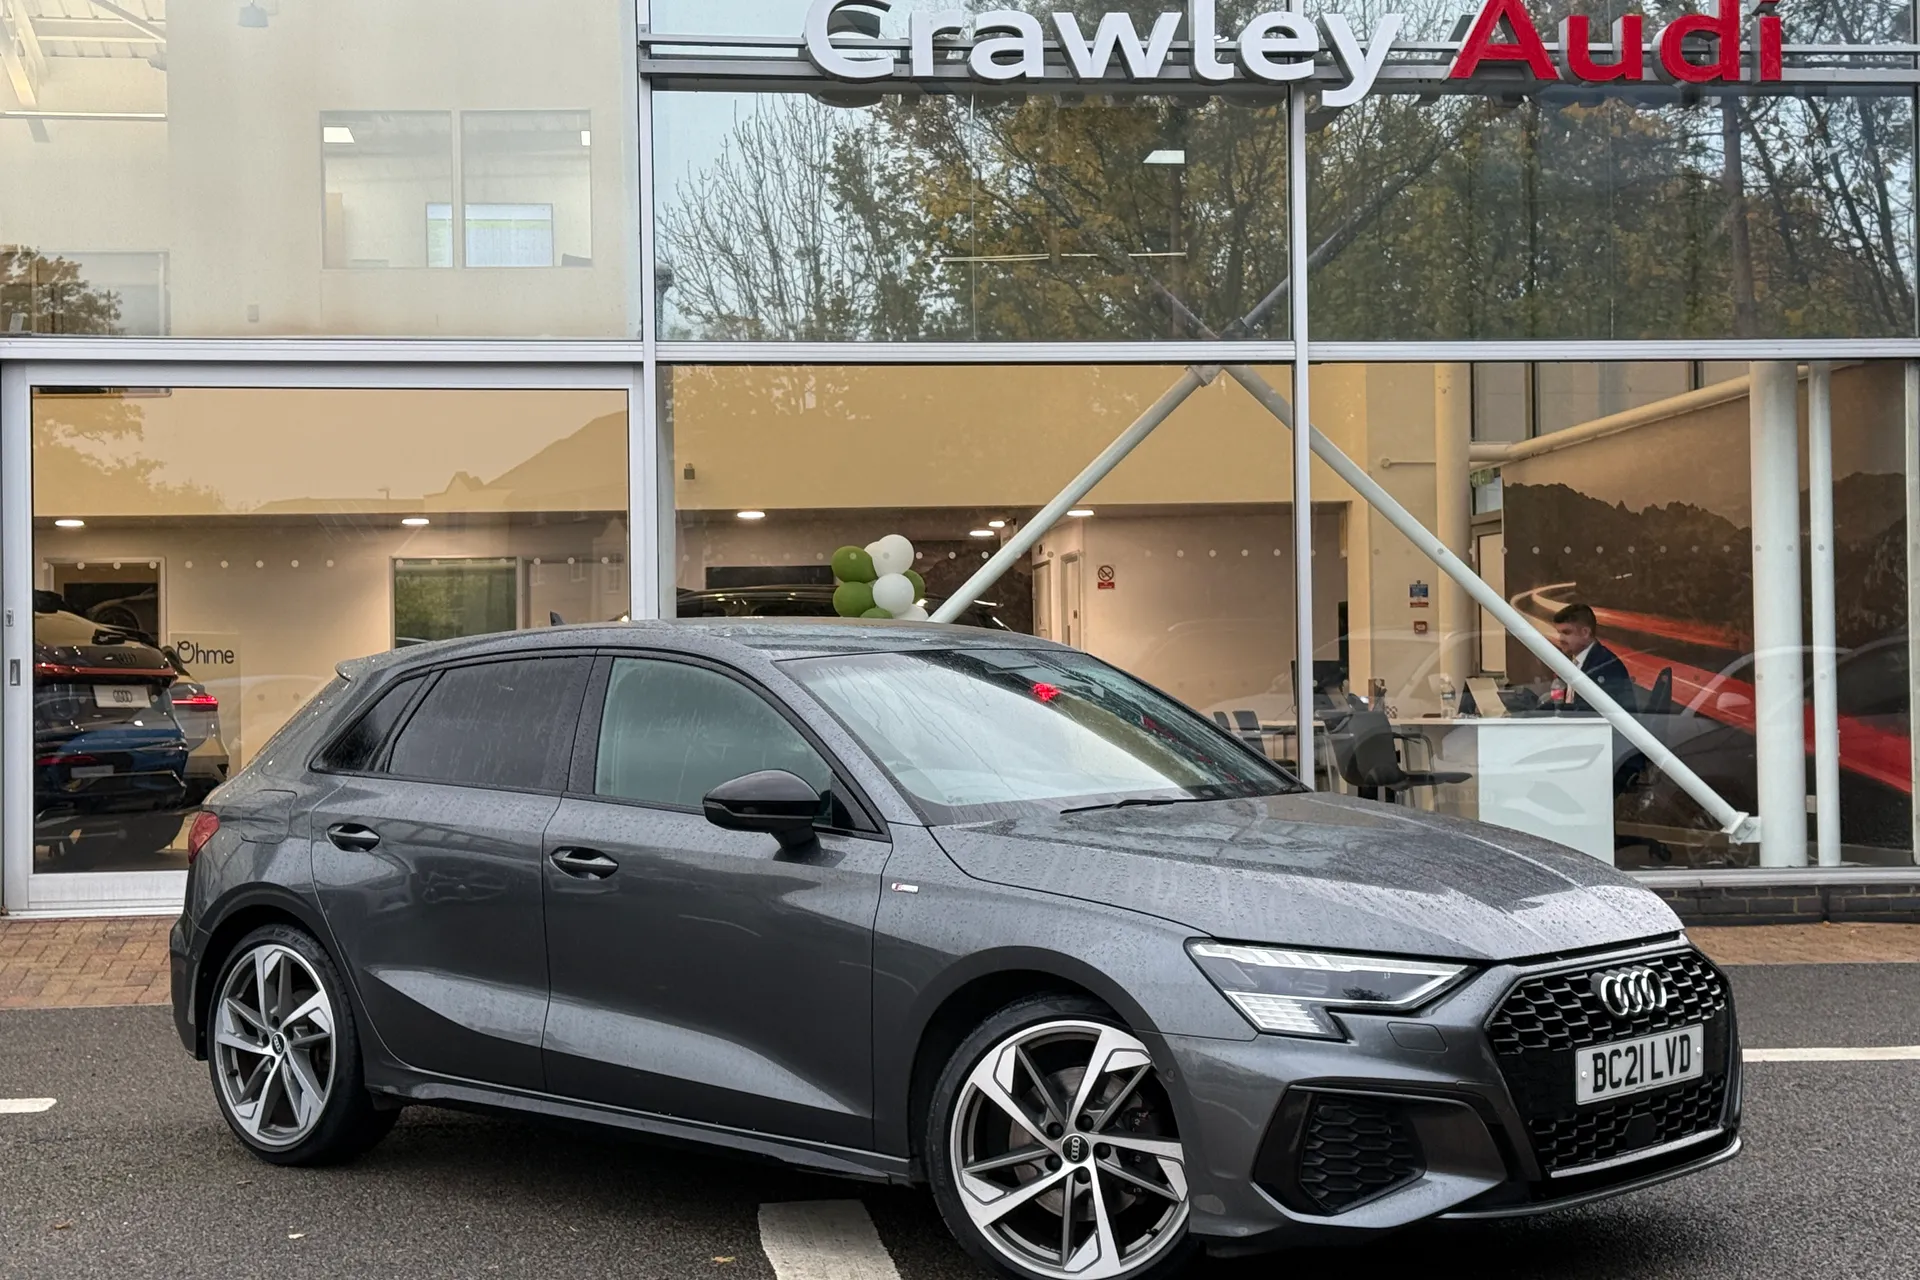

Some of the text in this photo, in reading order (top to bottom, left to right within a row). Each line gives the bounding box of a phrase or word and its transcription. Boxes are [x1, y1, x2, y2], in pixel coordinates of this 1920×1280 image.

[804, 0, 1783, 107] Crawley Audi
[177, 640, 235, 664] Ohme
[1592, 1034, 1692, 1094] BC21 LVD
